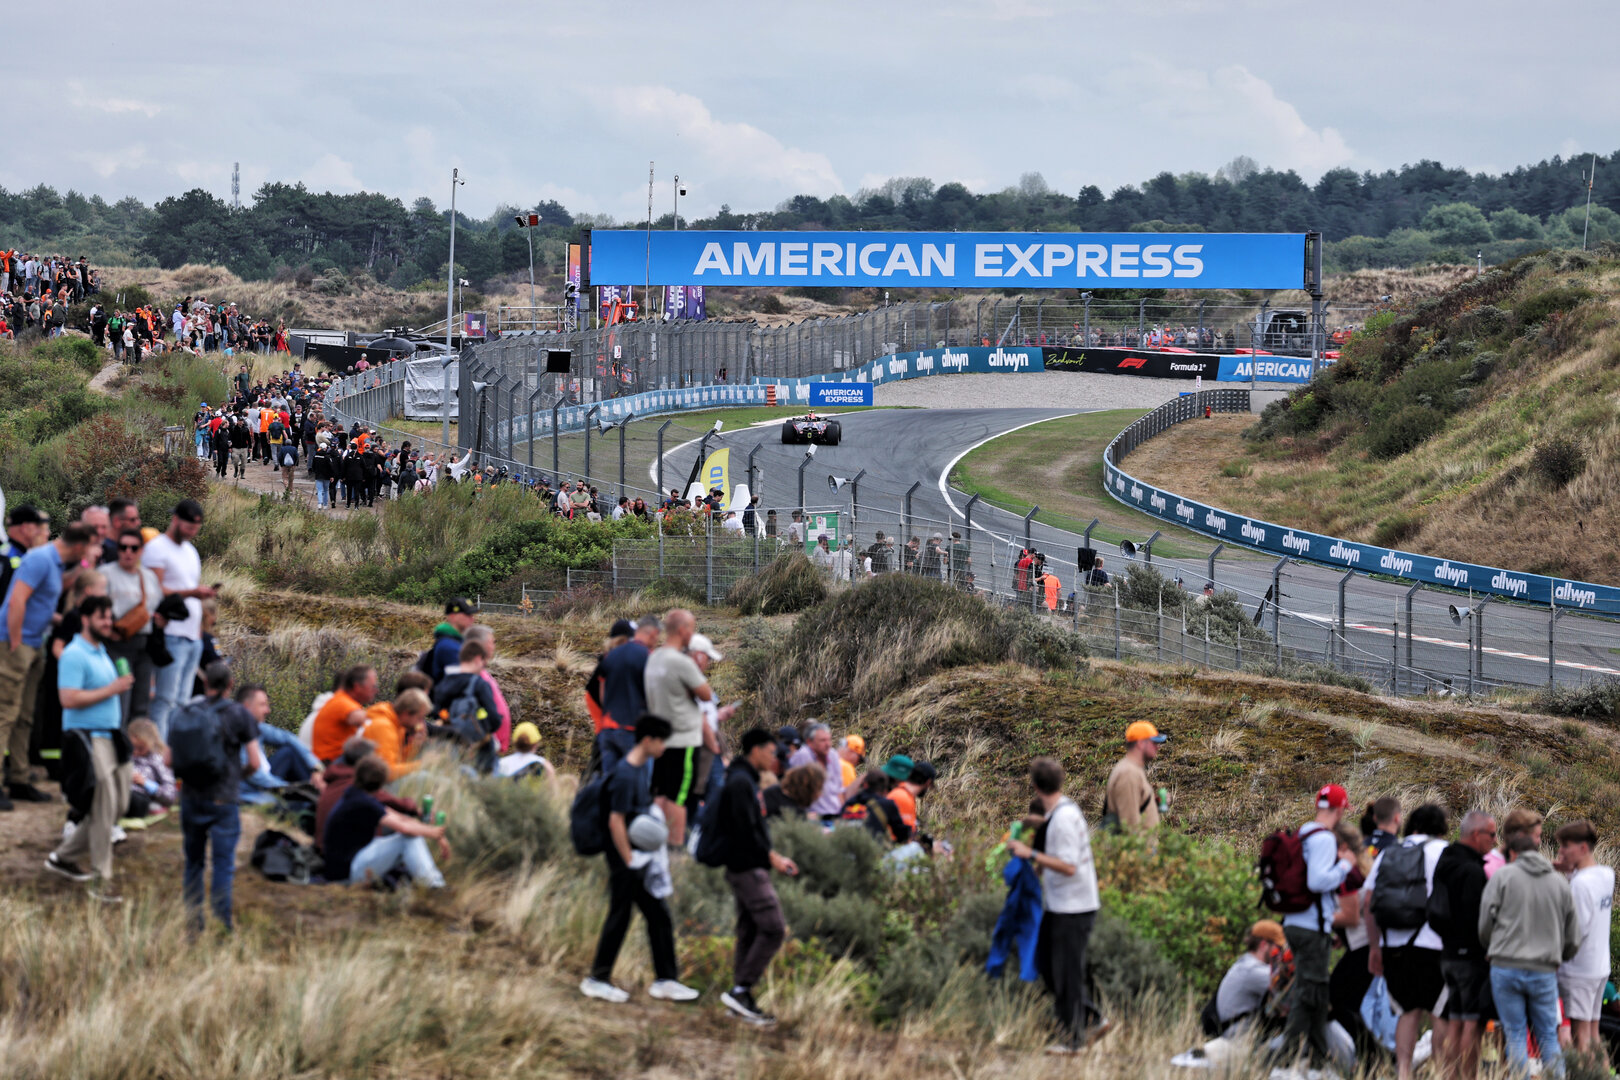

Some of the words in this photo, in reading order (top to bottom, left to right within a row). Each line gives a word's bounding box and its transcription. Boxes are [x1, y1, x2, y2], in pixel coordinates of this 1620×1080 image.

[693, 243, 956, 276] AMERICAN
[975, 244, 1204, 278] EXPRESS
[942, 349, 969, 372] allwyn
[989, 348, 1029, 372] allwyn
[1170, 362, 1198, 372] Formula
[1233, 362, 1311, 378] AMERICAN
[819, 388, 864, 396] AMERICAN
[1176, 500, 1195, 523] allwyn
[1205, 510, 1227, 534] allwyn
[1241, 520, 1266, 545] allwyn
[1282, 531, 1310, 555] allwyn
[1329, 541, 1360, 566] allwyn
[1380, 551, 1413, 576] allwyn
[1434, 562, 1468, 587] allwyn
[1491, 572, 1528, 597] allwyn
[1555, 582, 1596, 607] allwyn
